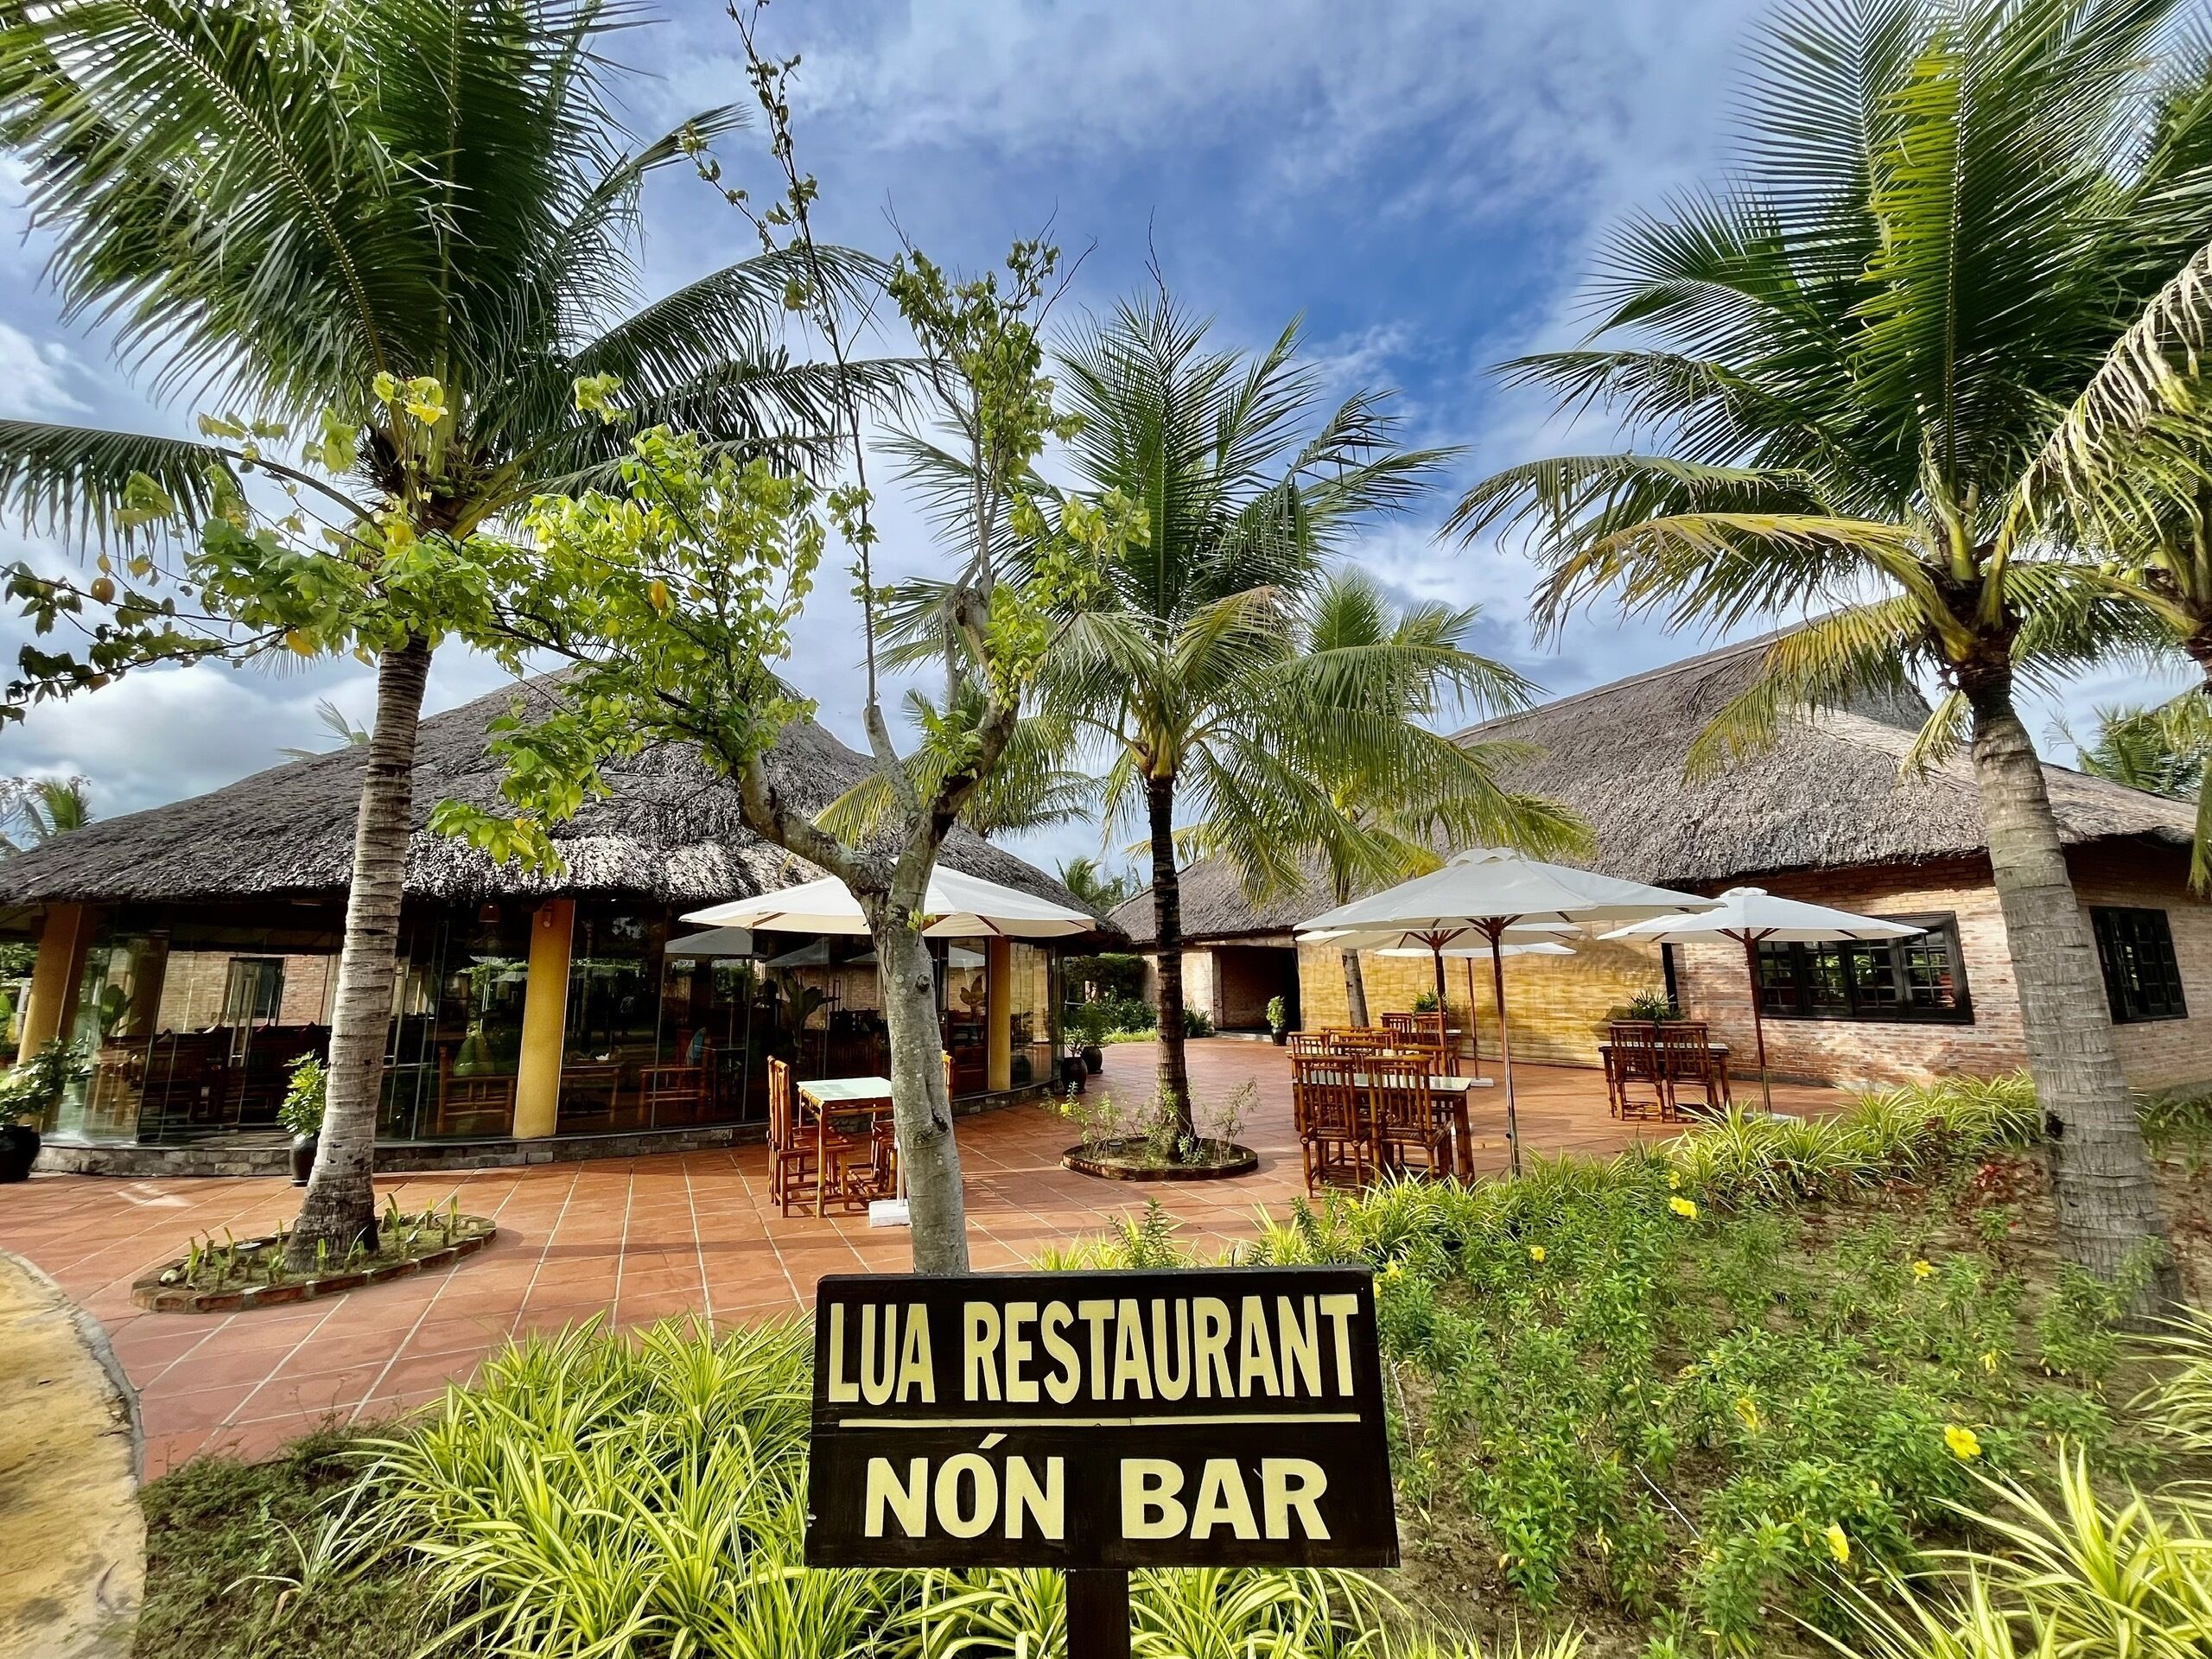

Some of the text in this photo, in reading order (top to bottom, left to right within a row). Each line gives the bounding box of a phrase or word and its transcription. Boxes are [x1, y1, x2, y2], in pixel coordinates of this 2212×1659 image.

[828, 1294, 1359, 1406] LUA RESTAURANT
[864, 1433, 1332, 1540] NÓN BAR
